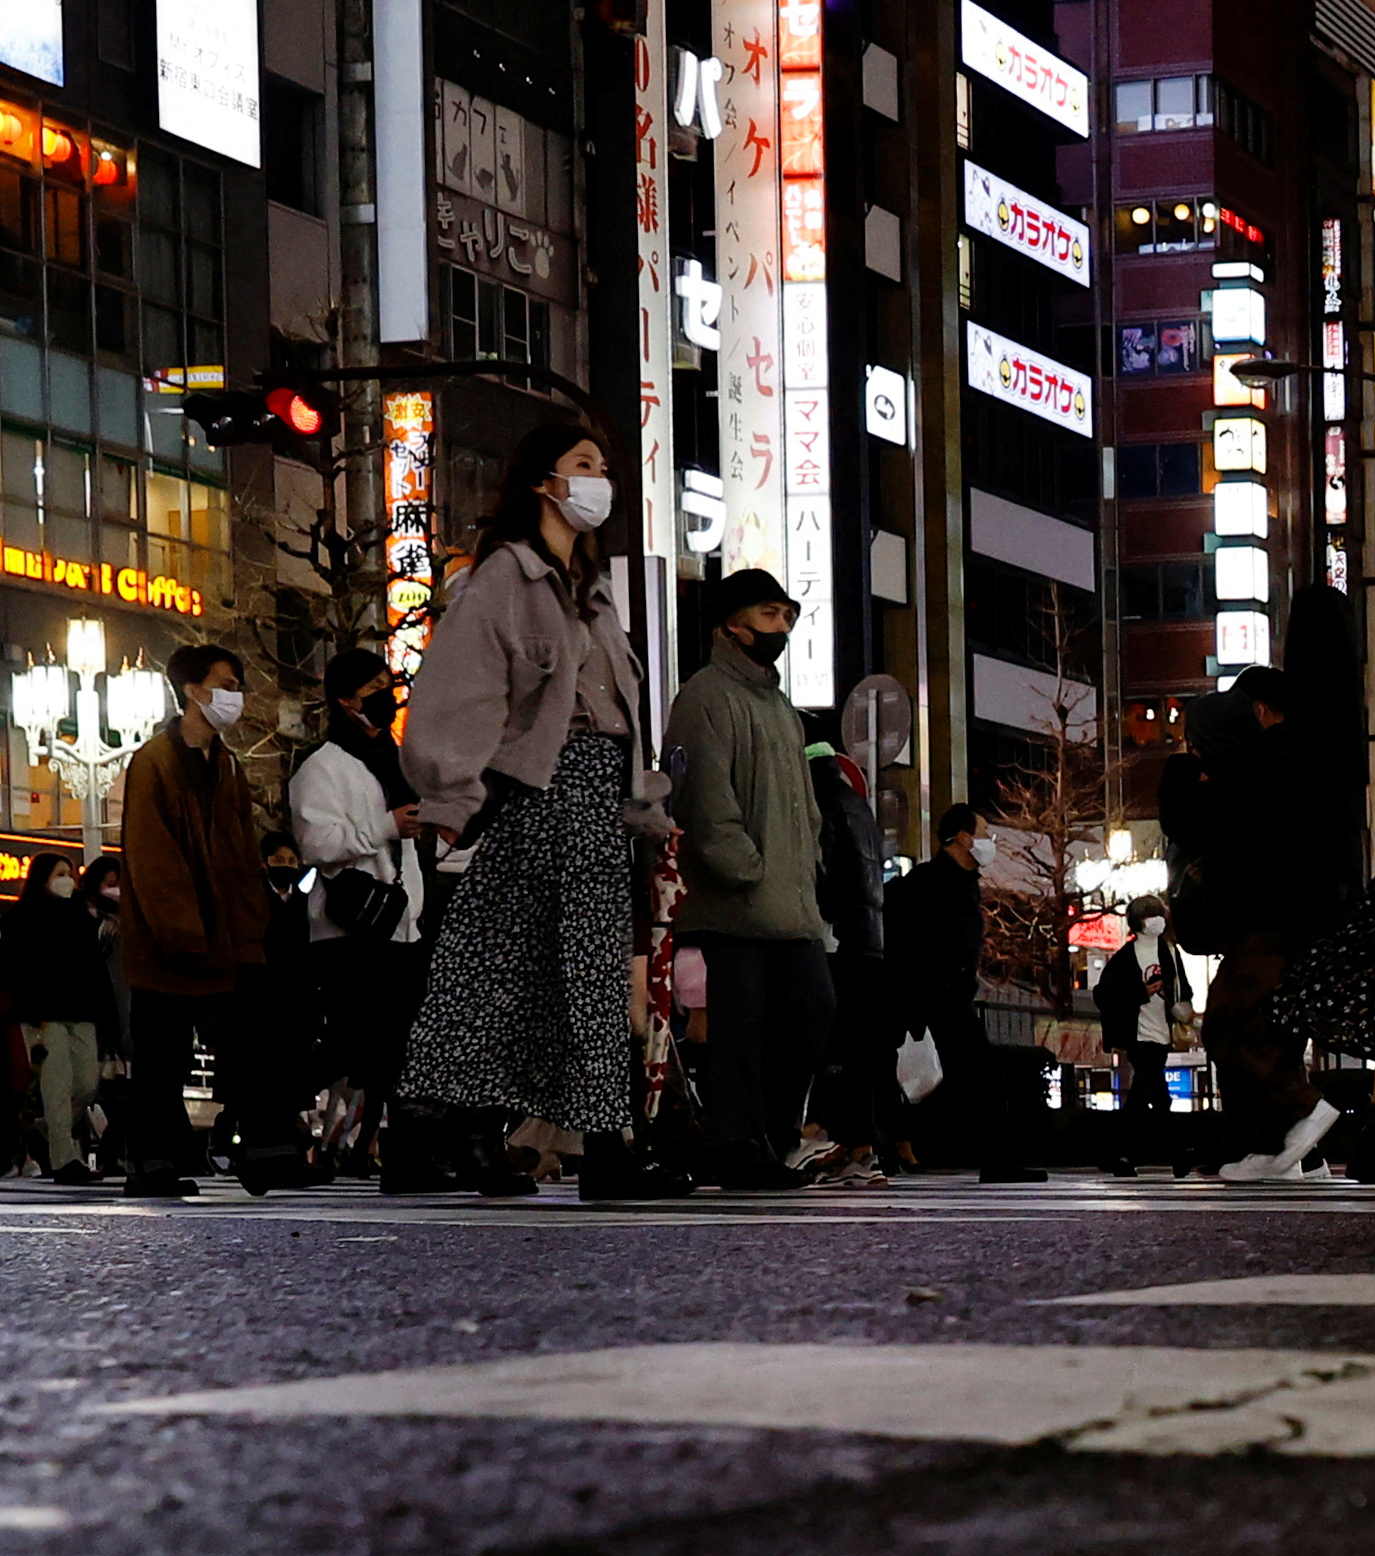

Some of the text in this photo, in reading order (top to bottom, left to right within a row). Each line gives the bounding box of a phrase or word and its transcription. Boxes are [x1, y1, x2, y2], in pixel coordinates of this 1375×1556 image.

[194, 44, 246, 82] オフィス
[1008, 44, 1069, 107] カラオケ
[1010, 202, 1072, 261] カラオケ
[674, 48, 728, 554] パセラ
[1012, 358, 1074, 413] カラオケ
[793, 399, 822, 487] ママ会
